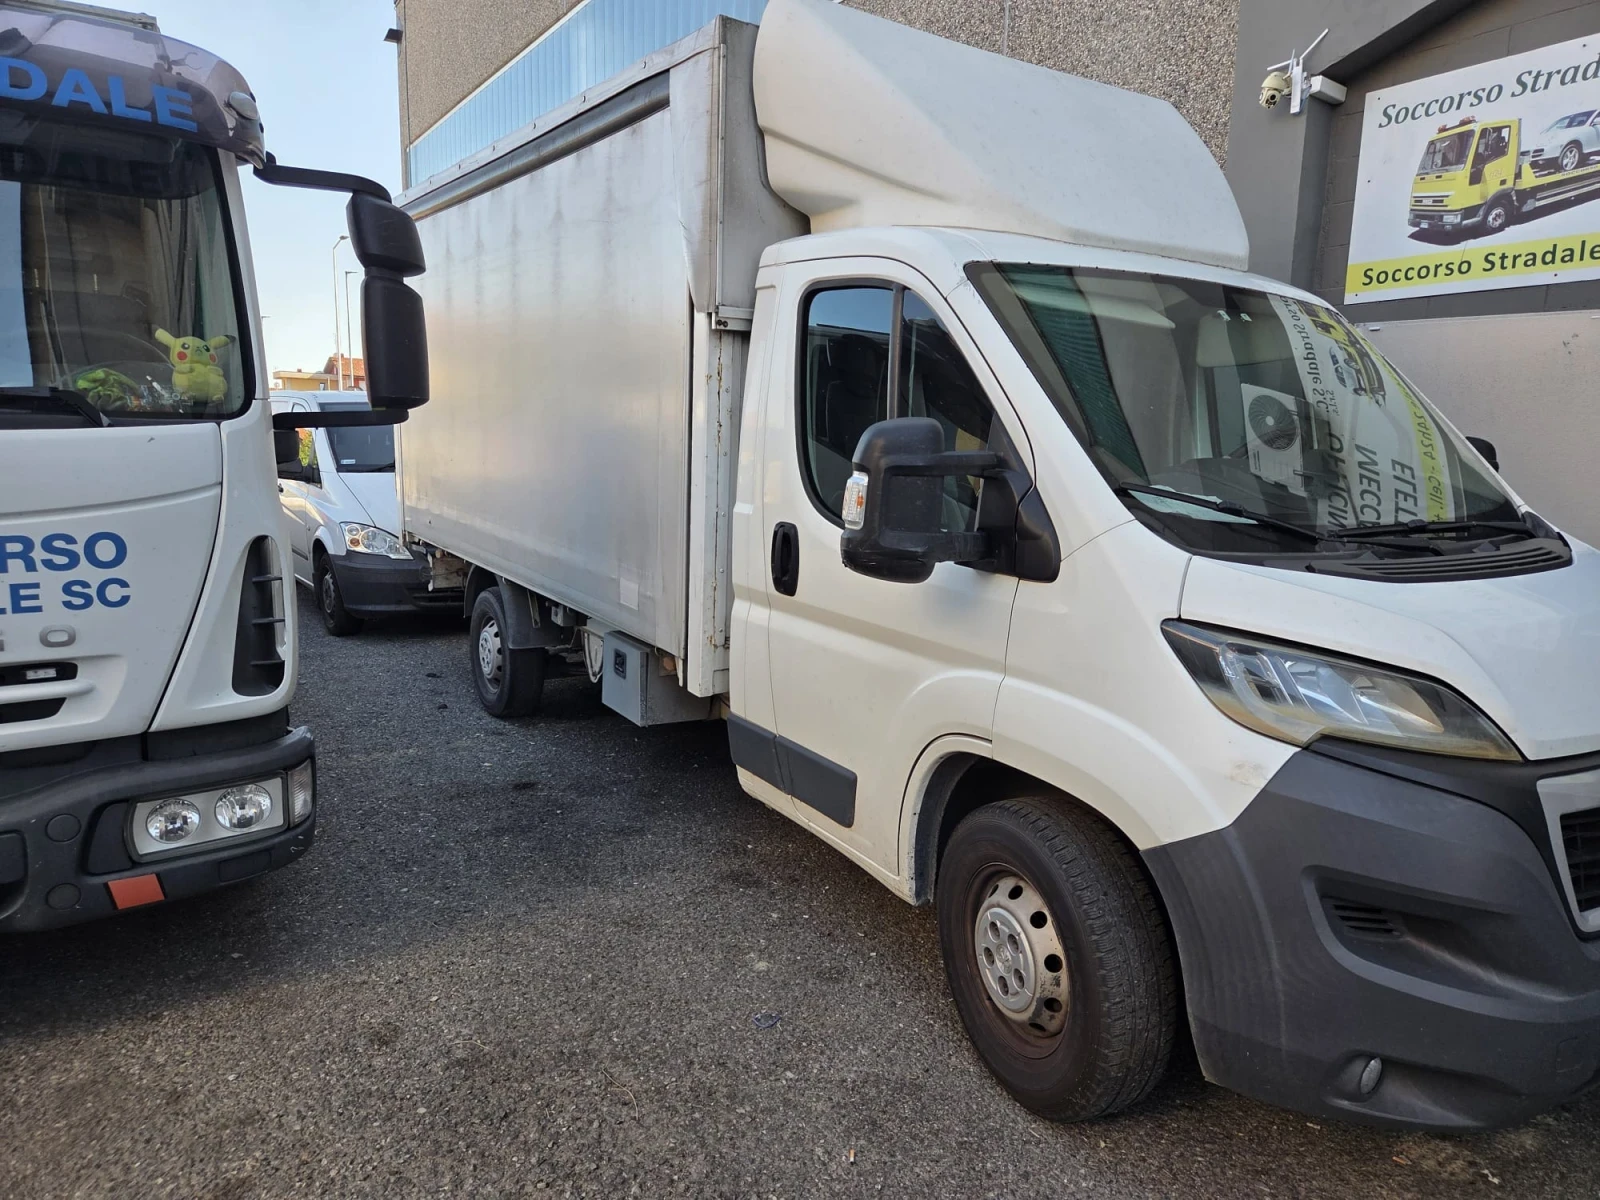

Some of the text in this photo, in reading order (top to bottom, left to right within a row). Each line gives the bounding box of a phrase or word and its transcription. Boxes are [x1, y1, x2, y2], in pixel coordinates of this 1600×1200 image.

[0, 56, 198, 133] DALE
[1378, 83, 1503, 129] Soccorso
[1362, 239, 1600, 286] Soccorso Stradale
[0, 531, 128, 574] RSO
[0, 577, 131, 615] E SC
